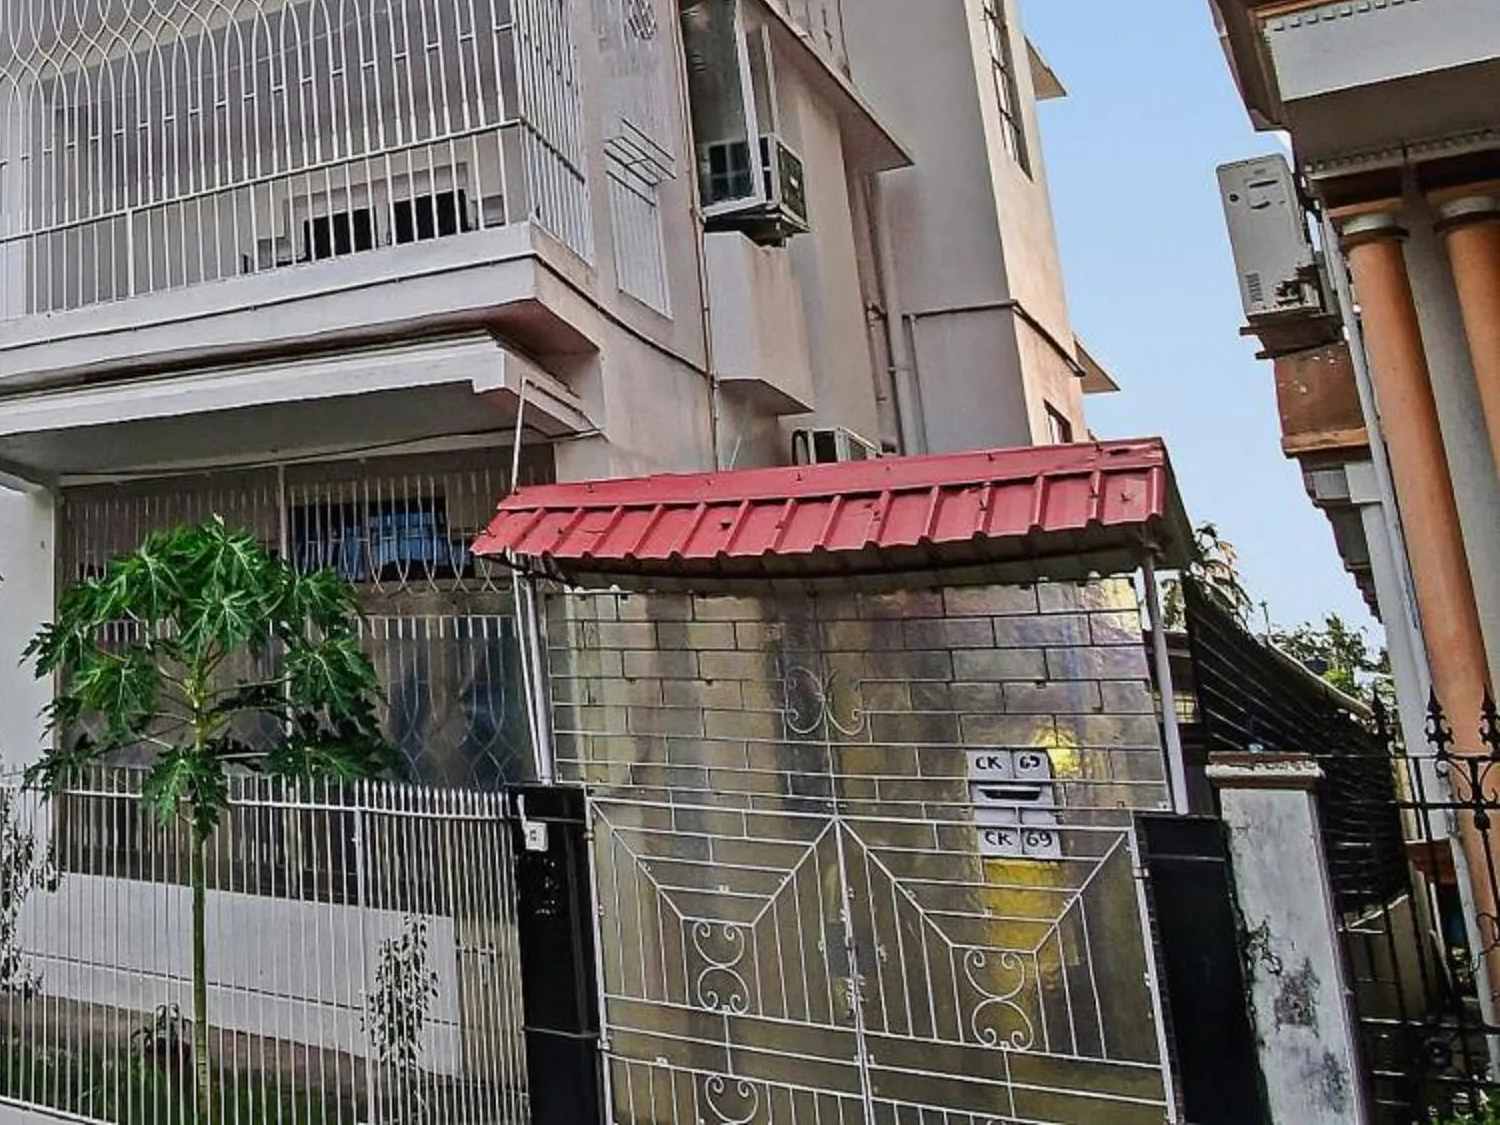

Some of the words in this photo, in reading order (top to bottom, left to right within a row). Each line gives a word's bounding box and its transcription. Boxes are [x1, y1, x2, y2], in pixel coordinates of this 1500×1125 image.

[975, 755, 1003, 770] CK
[984, 830, 1013, 846] CK
[1025, 831, 1053, 848] 69
